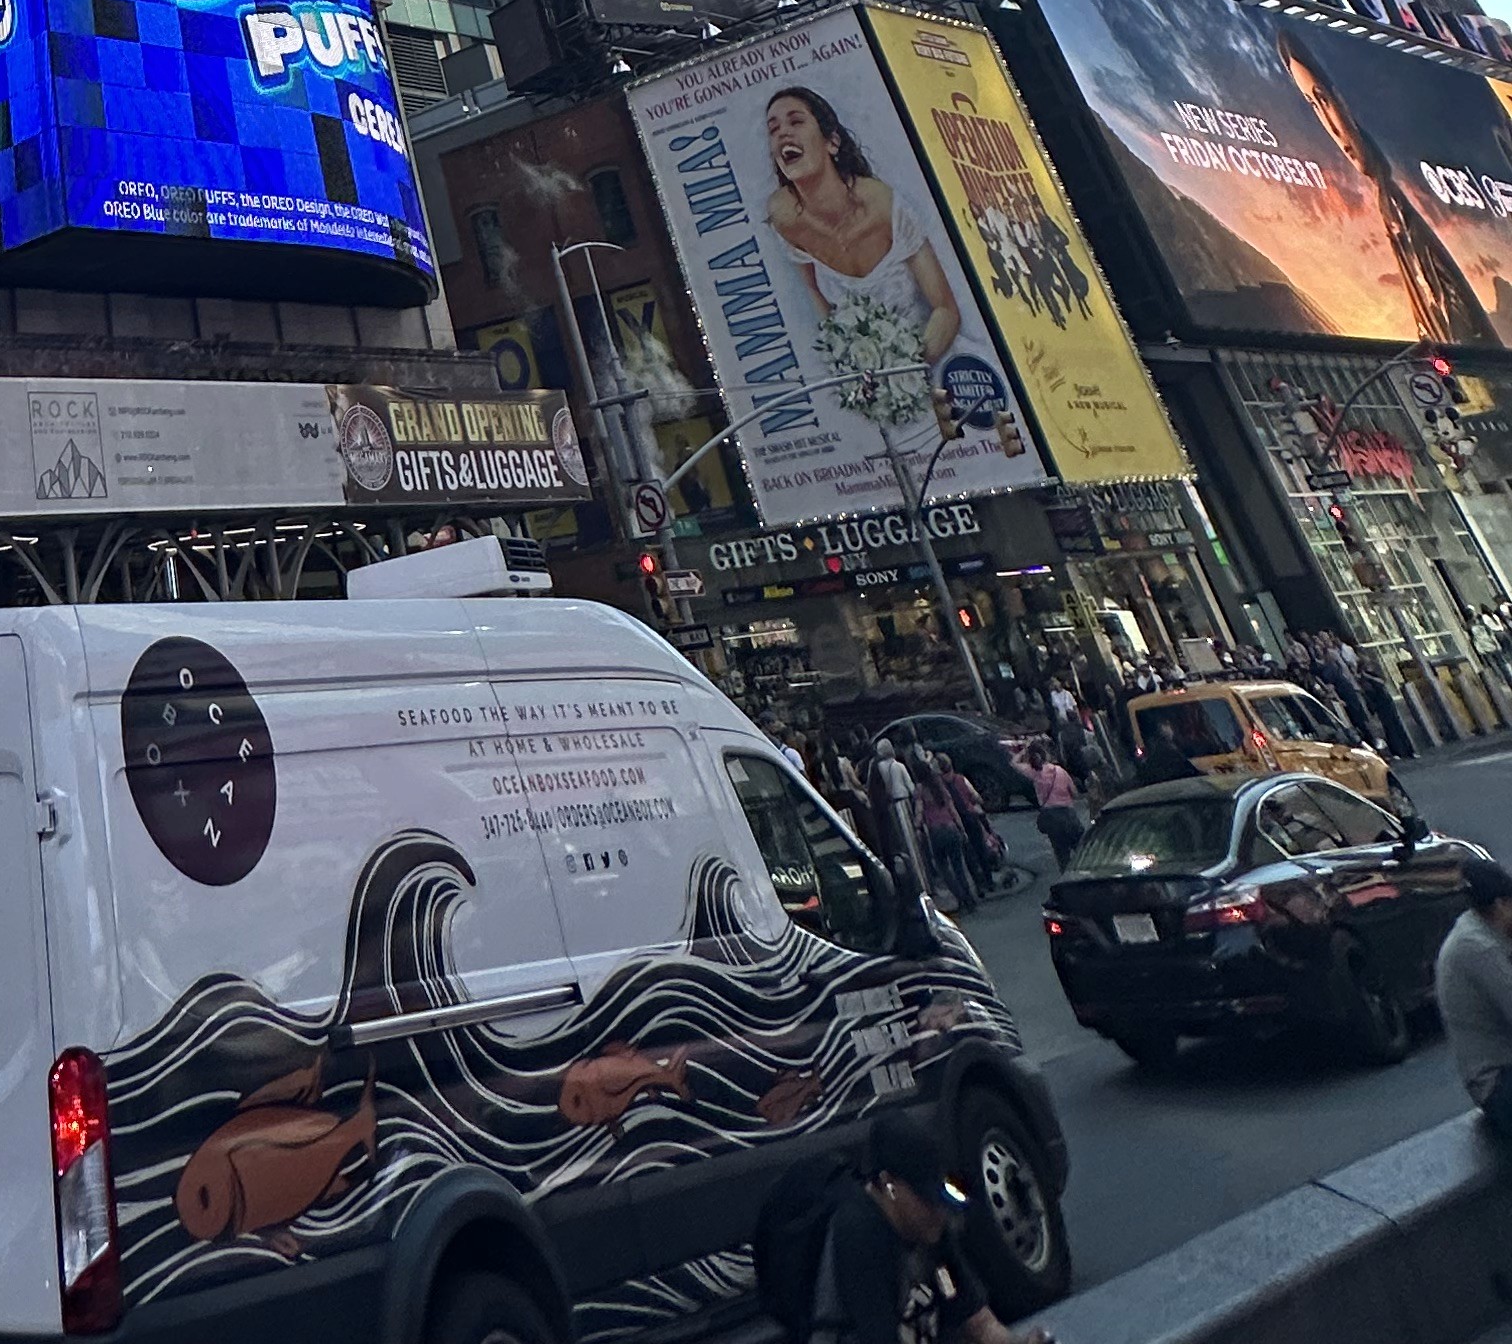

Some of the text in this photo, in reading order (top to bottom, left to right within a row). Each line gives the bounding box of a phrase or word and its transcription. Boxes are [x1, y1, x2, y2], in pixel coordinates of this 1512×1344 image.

[245, 11, 389, 78] PUFFS
[674, 31, 813, 92] YOU ALREADY KNOW
[644, 93, 692, 122] YOU'RE
[693, 75, 743, 108] GONNA
[743, 63, 782, 88] LOVE
[811, 32, 864, 64] AGAIN!
[347, 91, 408, 155] CEREA
[930, 107, 1029, 173] OPERATION
[1172, 100, 1279, 148] NEW SERIES
[668, 124, 750, 238] MIA!
[1160, 131, 1328, 190] FRIDAY OCTOBER 17
[118, 179, 160, 202] OREO,
[240, 193, 261, 209] the
[261, 195, 295, 213] OREO
[1435, 164, 1486, 210] CBS
[103, 200, 142, 221] OREO
[143, 203, 171, 222] Blue
[172, 206, 204, 224] color
[205, 210, 227, 226] are
[227, 211, 297, 233] trademarks
[707, 235, 820, 438] MAMMA
[947, 369, 994, 385] STRICTLY
[951, 383, 995, 398] LIMITED
[31, 399, 95, 420] ROCK
[388, 400, 550, 444] GRAND OPENING
[762, 474, 794, 493] BACK
[794, 471, 813, 487] ON
[813, 459, 877, 484] BROADWAY
[709, 532, 799, 573] GIFTS
[1148, 532, 1175, 547] SONY
[855, 569, 900, 588] SONY
[397, 699, 681, 727] SEAFOOD THE WAY IT'S MEANT TO BE
[467, 731, 646, 758] AT HOME & WHOLESALE
[491, 766, 648, 796] OCEANBOXSEAFOOD.COM
